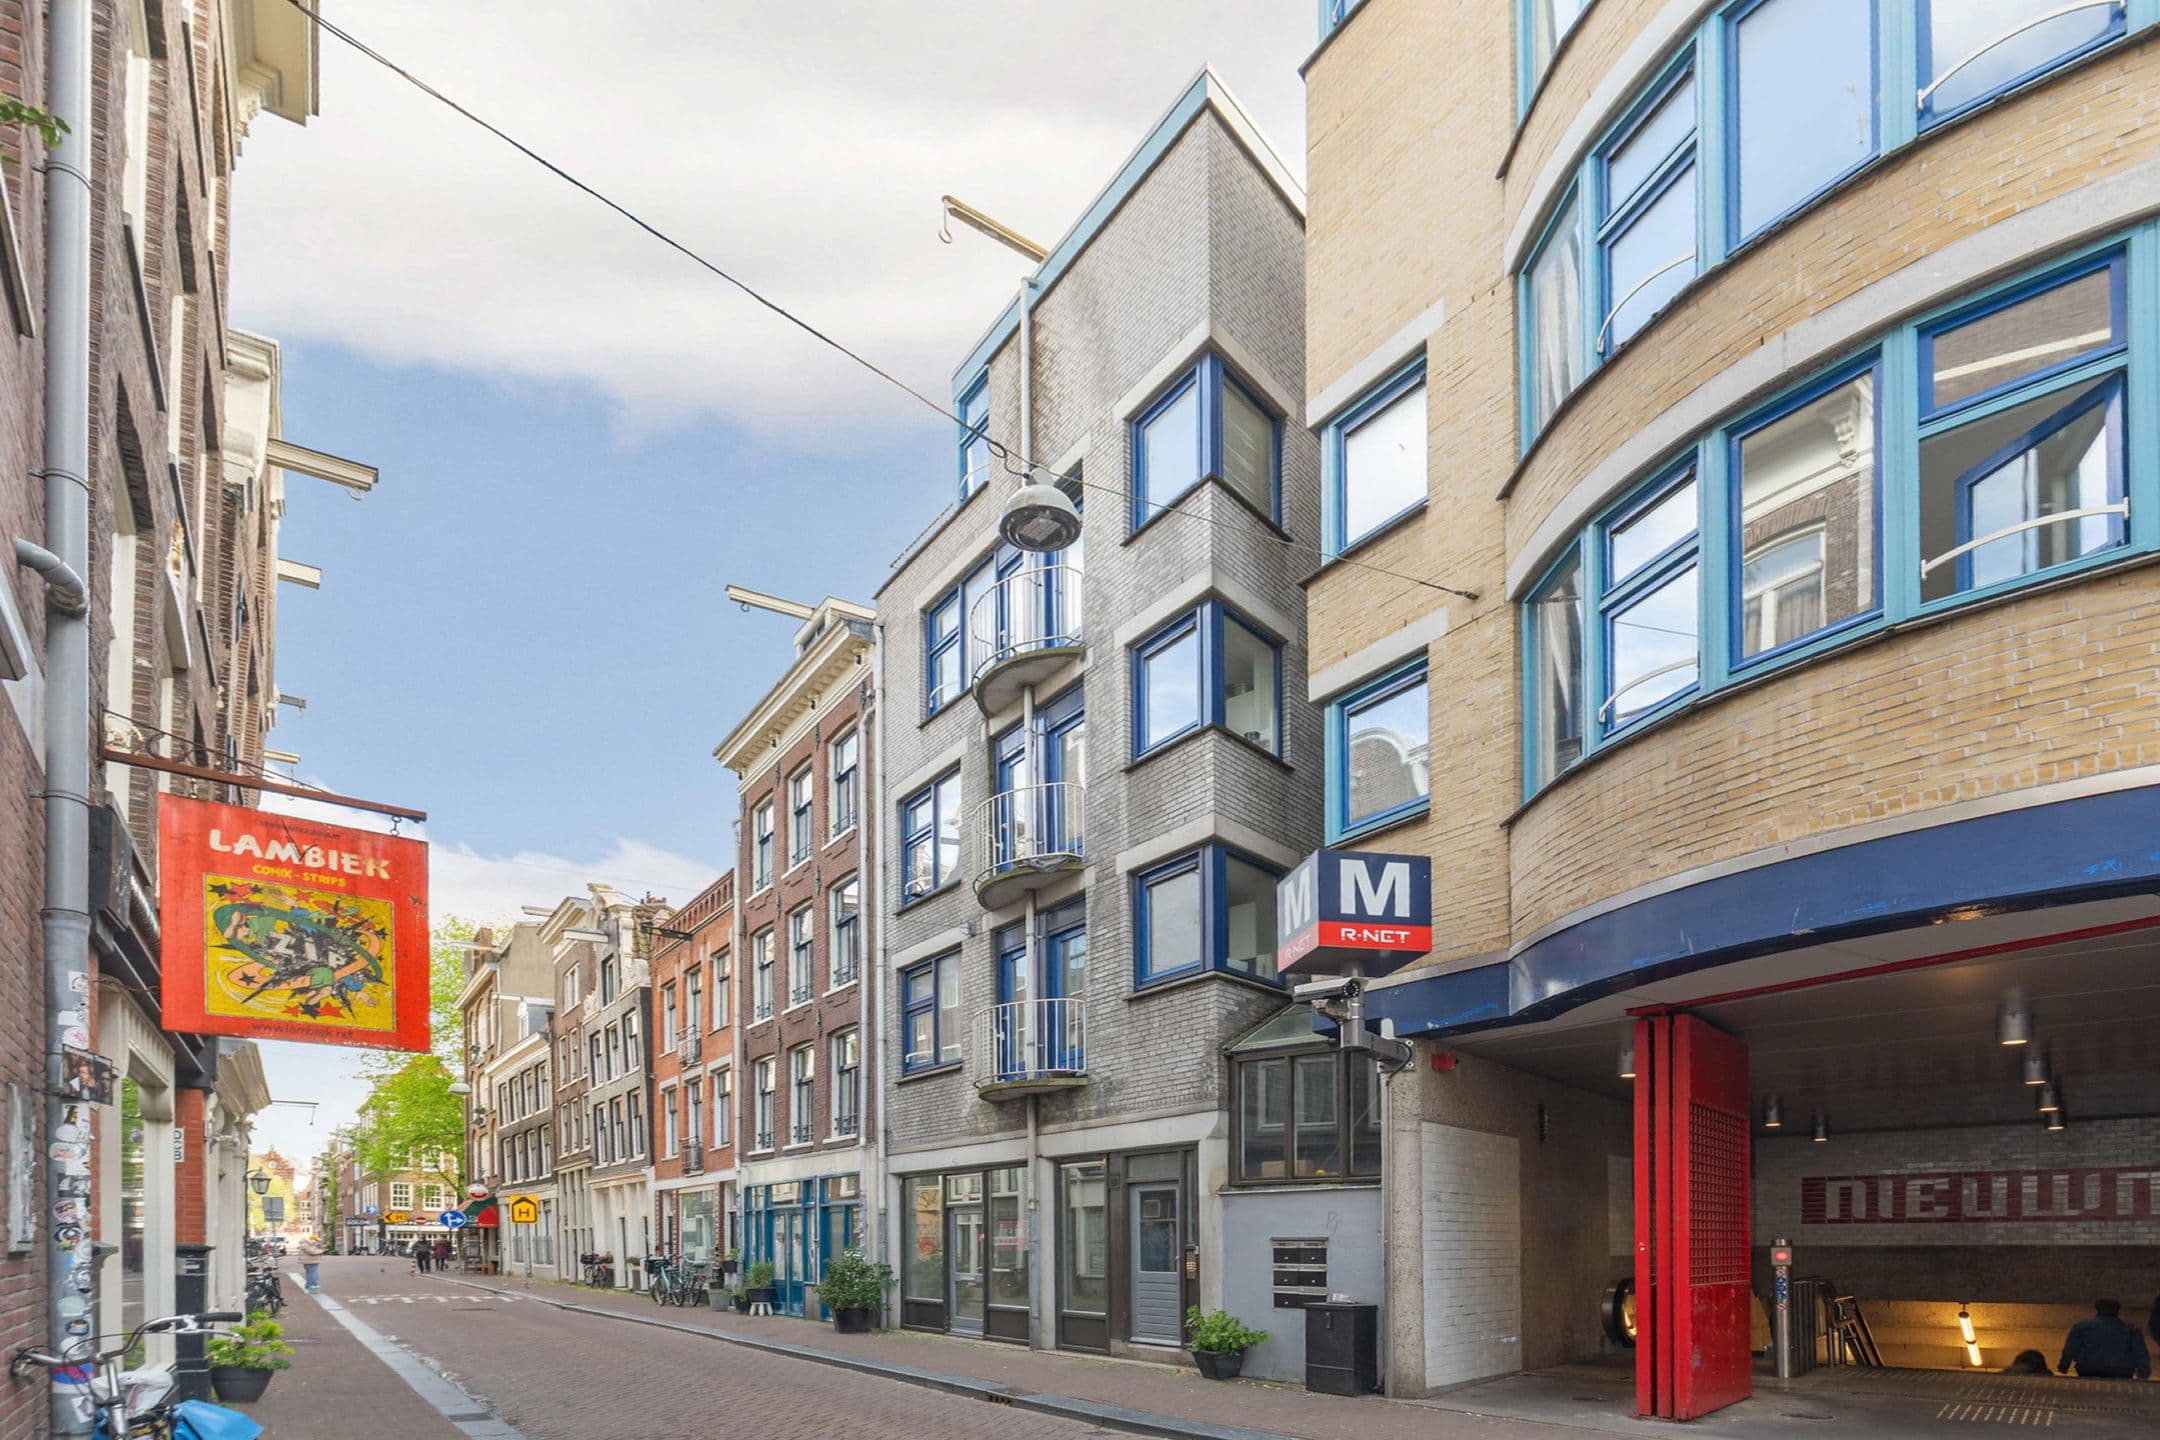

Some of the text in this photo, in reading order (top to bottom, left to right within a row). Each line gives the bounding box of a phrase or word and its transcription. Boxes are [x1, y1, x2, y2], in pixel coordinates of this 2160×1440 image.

[209, 828, 391, 880] LAMBIEK
[252, 864, 293, 878] COMIX
[302, 872, 348, 888] STRIPS
[1284, 865, 1311, 937] M
[1340, 858, 1411, 919] M
[267, 931, 349, 970] ZIP
